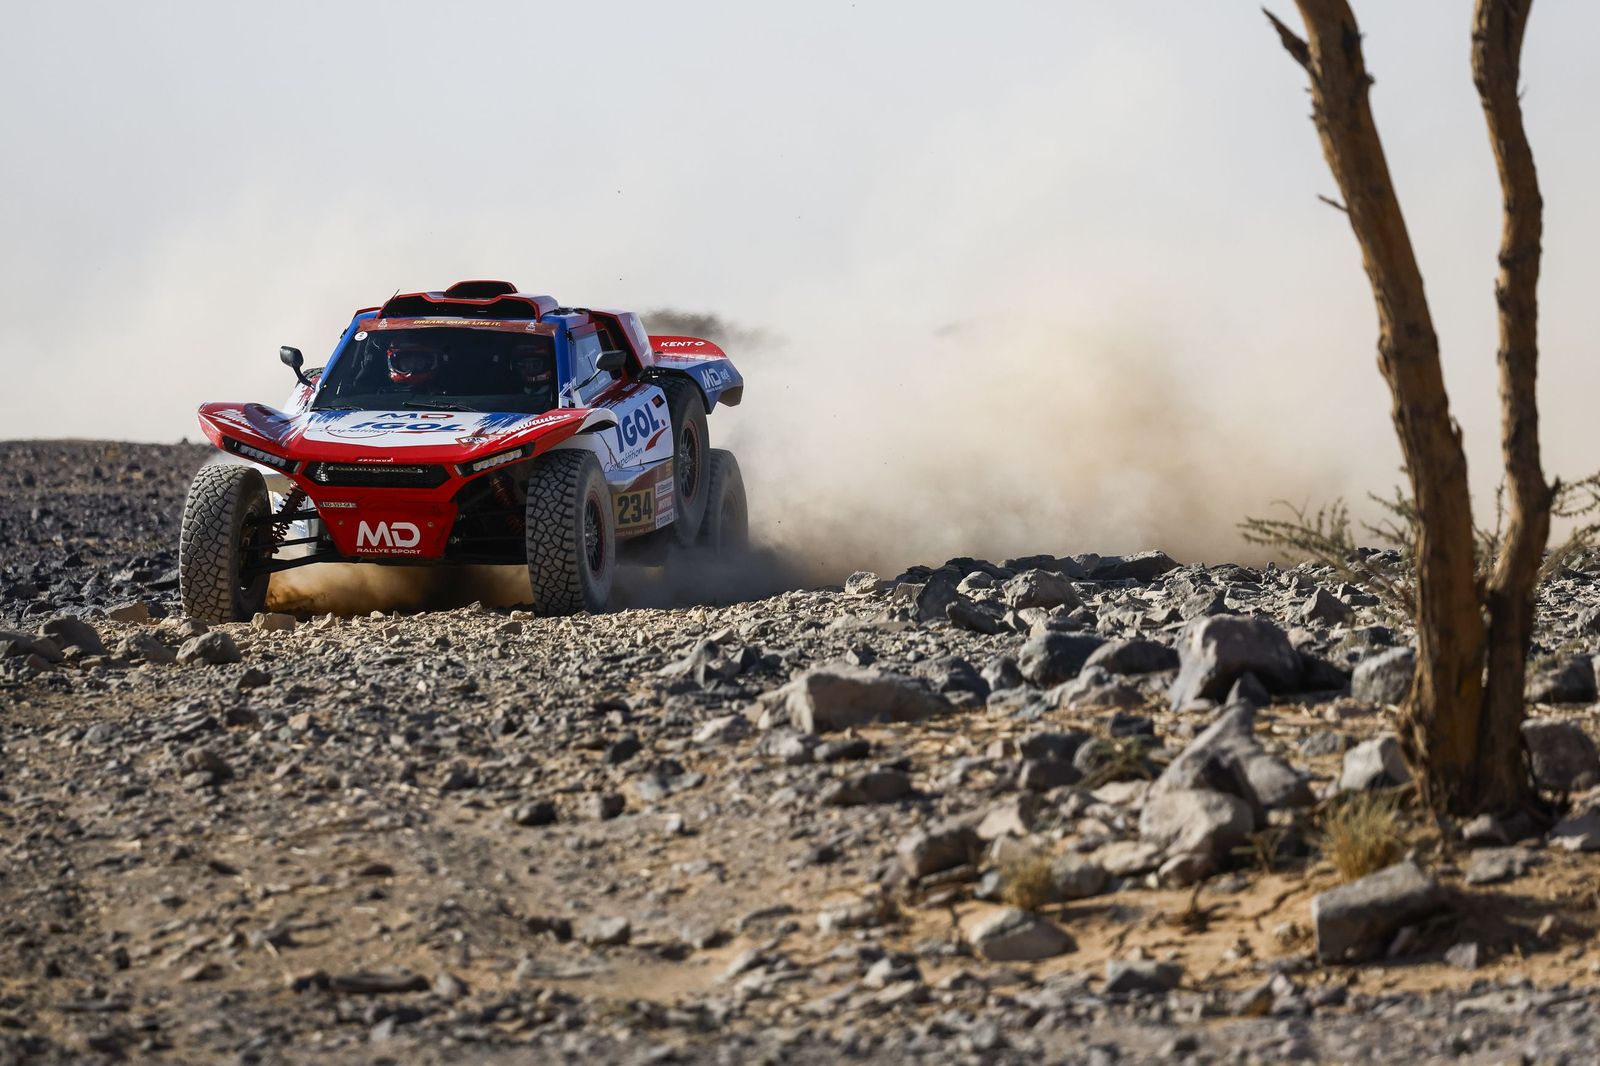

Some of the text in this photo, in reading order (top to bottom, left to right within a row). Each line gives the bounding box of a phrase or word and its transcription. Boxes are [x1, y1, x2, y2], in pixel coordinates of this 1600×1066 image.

[701, 367, 721, 389] MD
[350, 421, 464, 431] IGOL
[615, 402, 660, 453] IGOL
[617, 490, 653, 524] 234
[356, 520, 421, 548] MD
